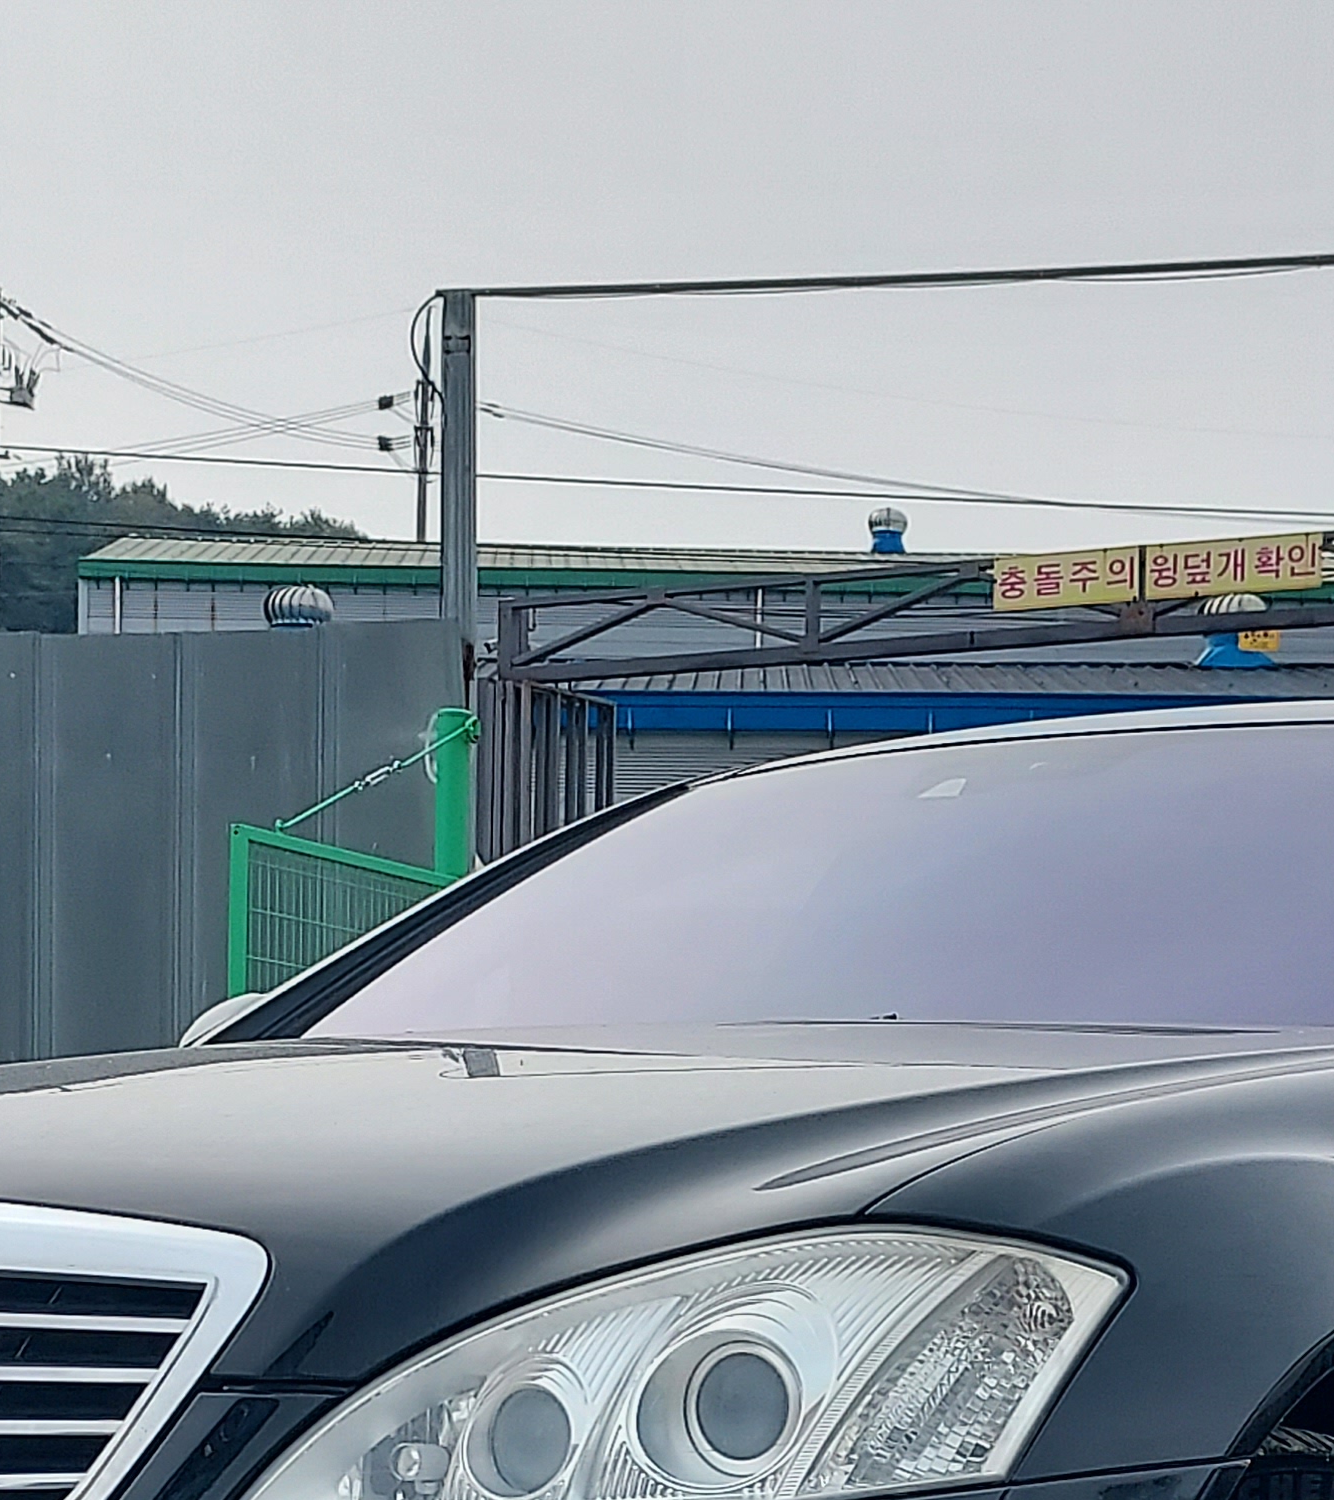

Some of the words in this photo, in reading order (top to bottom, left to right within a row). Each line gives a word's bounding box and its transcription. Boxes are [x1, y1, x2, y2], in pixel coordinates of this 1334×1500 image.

[998, 556, 1135, 600] 충돌주의
[1149, 547, 1246, 588] 윙덮개
[1254, 542, 1317, 579] 확인
